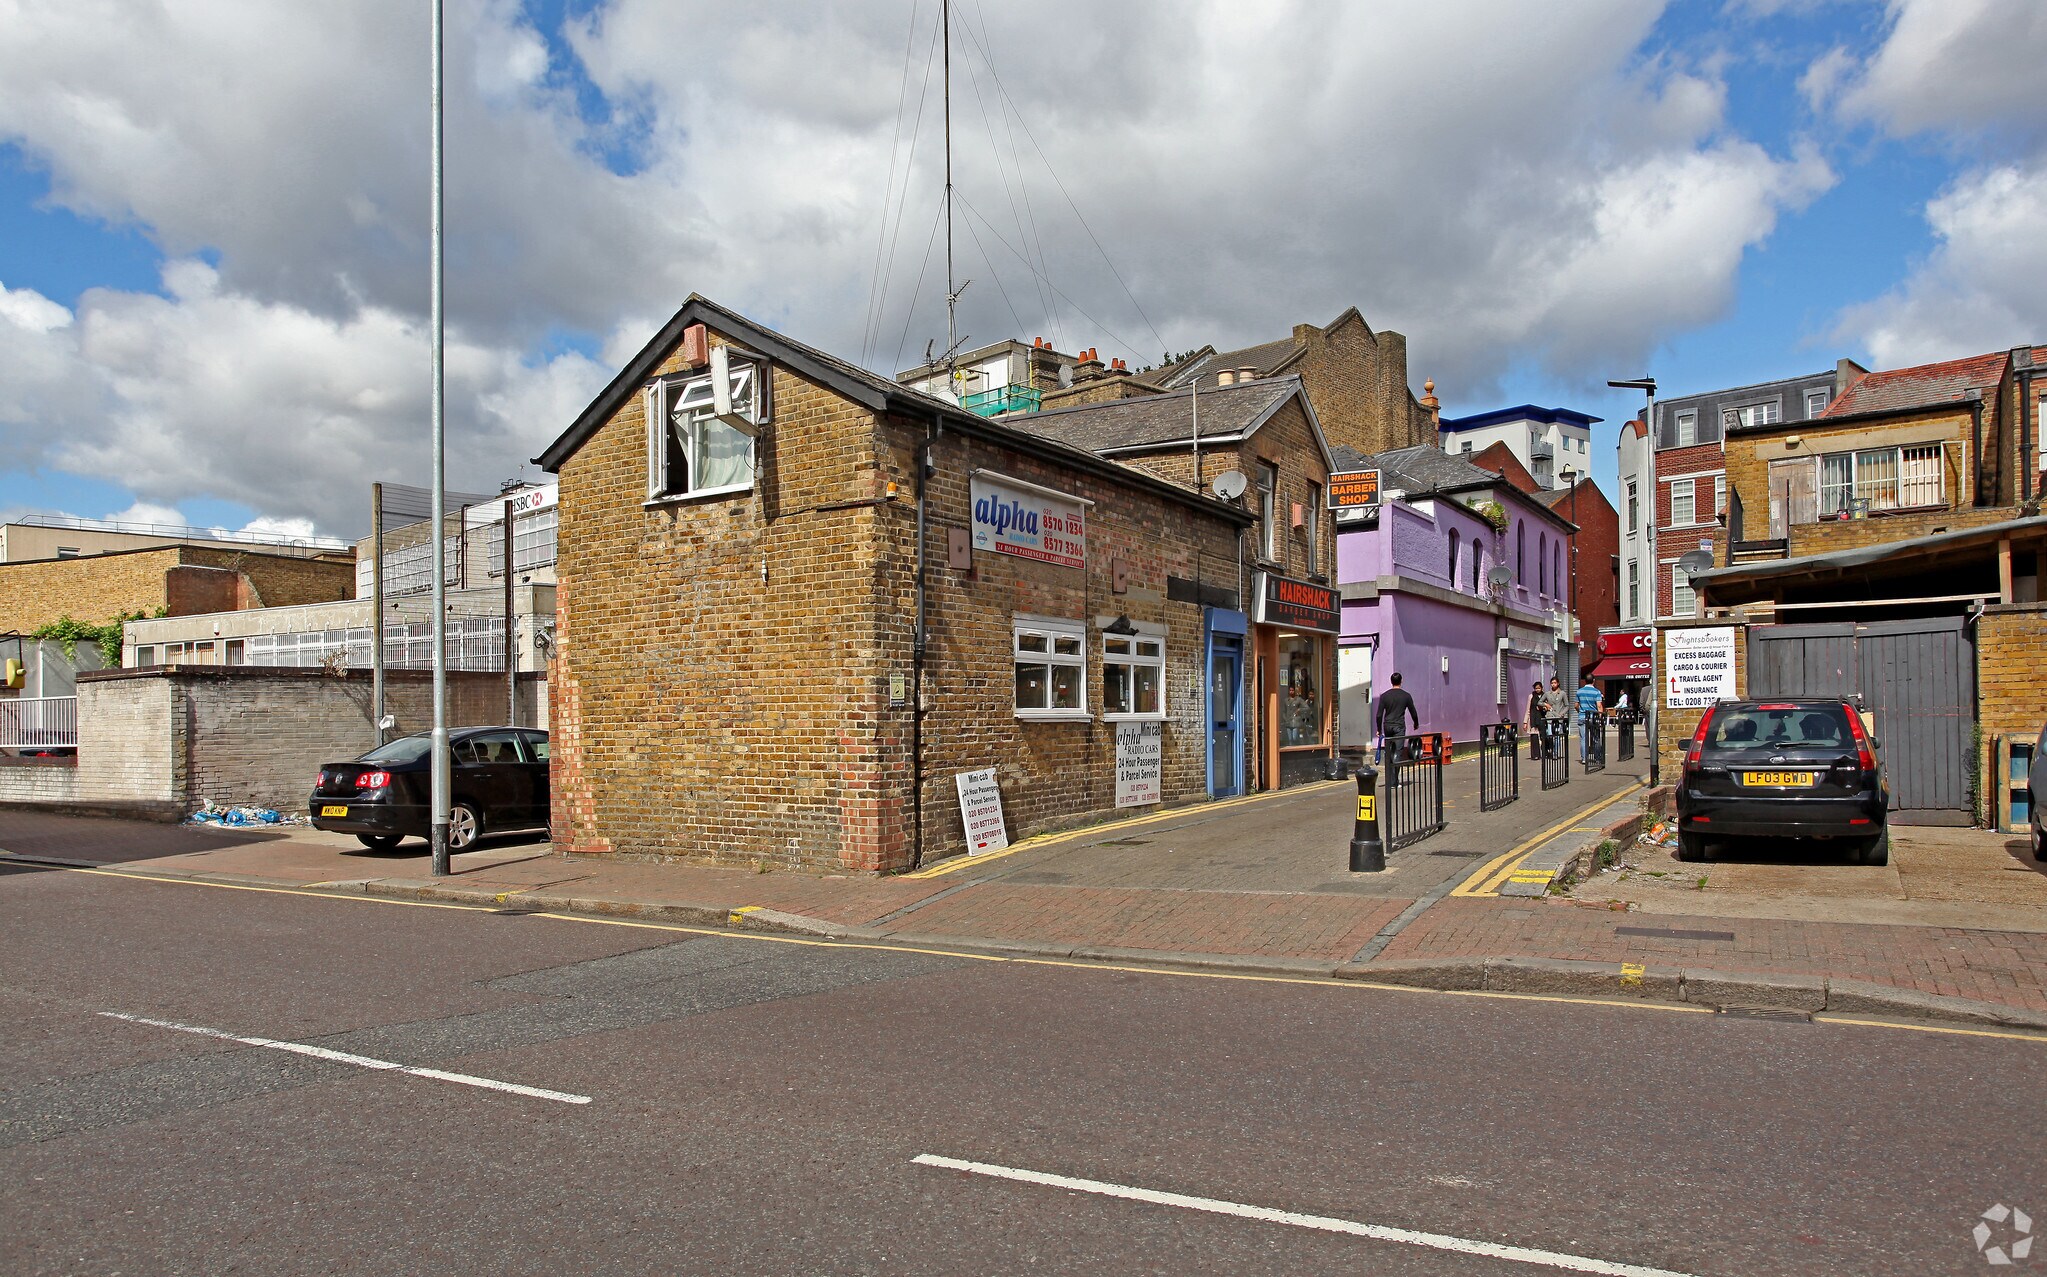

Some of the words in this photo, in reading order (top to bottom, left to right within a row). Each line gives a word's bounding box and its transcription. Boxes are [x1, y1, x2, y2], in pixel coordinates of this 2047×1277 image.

[1331, 472, 1377, 482] HAIRSHACK
[1331, 483, 1377, 495] BARBER
[512, 495, 531, 512] HSBC
[1339, 495, 1369, 505] SHOP
[975, 495, 1038, 535] alpha
[1043, 508, 1052, 516] 020
[1043, 515, 1063, 532] 8570
[1065, 521, 1083, 536] 1234
[1009, 533, 1025, 543] RADIO
[1044, 537, 1063, 552] 8577
[1065, 541, 1084, 557] 3366
[1004, 545, 1018, 553] HOUR
[1019, 547, 1045, 559] PASSENGER
[1050, 555, 1066, 564] PARCEL
[1066, 558, 1083, 568] SERVICE
[1279, 581, 1331, 610] HAIRSHACK
[1279, 604, 1308, 617] BARBER
[1698, 651, 1726, 659] BAGGAGE
[1669, 698, 1683, 706] TEL:
[1685, 697, 1702, 706] 0208
[1151, 722, 1161, 736] cab
[1117, 729, 1141, 750] alpha
[1127, 745, 1144, 755] RADIO
[1145, 744, 1159, 754] CARS
[1118, 758, 1125, 768] 24
[1125, 758, 1136, 768] Hour
[1137, 757, 1160, 768] Passenger
[968, 774, 978, 783] Mini
[979, 772, 988, 781] cab
[1120, 772, 1125, 781] &
[1126, 770, 1140, 781] Parcel
[1141, 769, 1158, 780] Service
[1748, 773, 1780, 784] LF03
[1783, 773, 1808, 784] GWD
[978, 786, 998, 794] Passenger
[971, 798, 983, 806] Parcel
[983, 795, 996, 803] Service
[968, 810, 977, 818] 020
[970, 822, 979, 830] 020
[972, 834, 981, 842] 020
